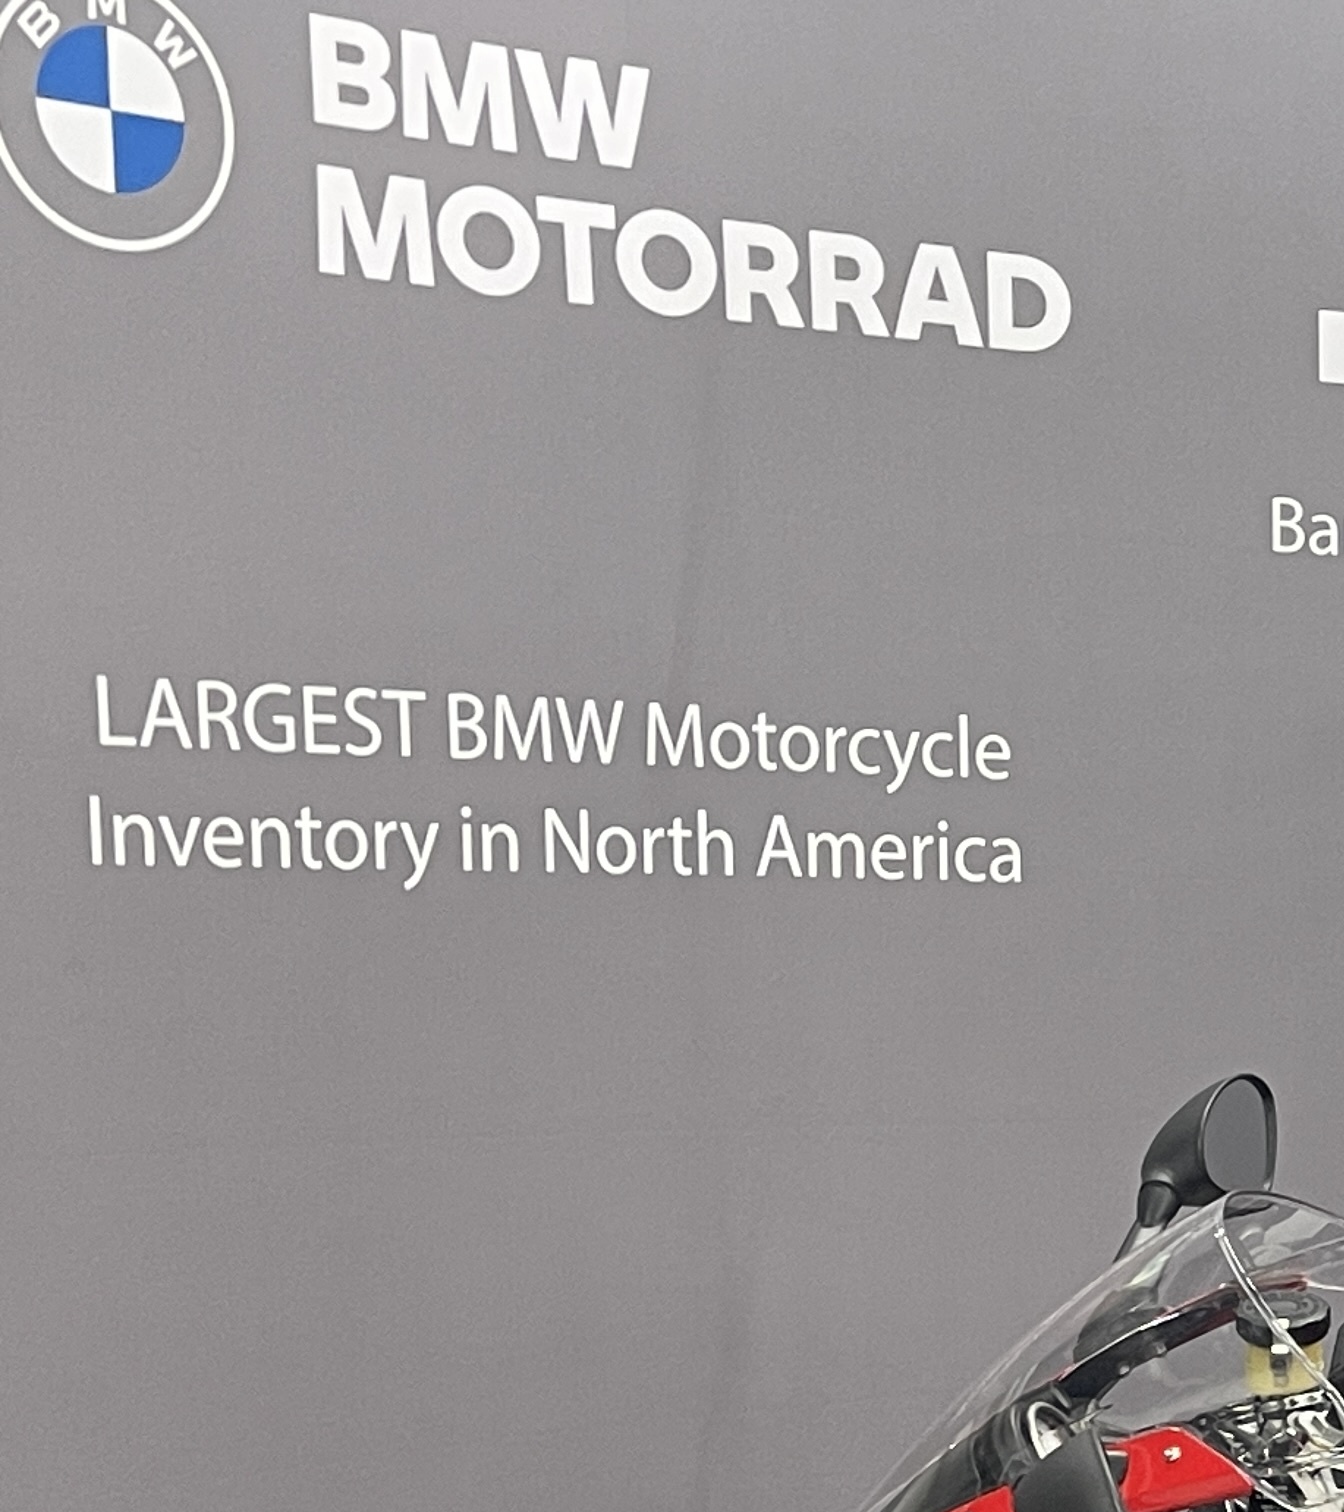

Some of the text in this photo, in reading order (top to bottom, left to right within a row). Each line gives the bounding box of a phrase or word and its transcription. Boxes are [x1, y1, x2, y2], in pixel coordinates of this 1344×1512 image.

[308, 12, 650, 169] BMW
[316, 163, 1072, 352] MOTORRAD
[96, 674, 1011, 794] LARGEST BMW Motorcycle
[89, 794, 1023, 891] Inventory in North America
